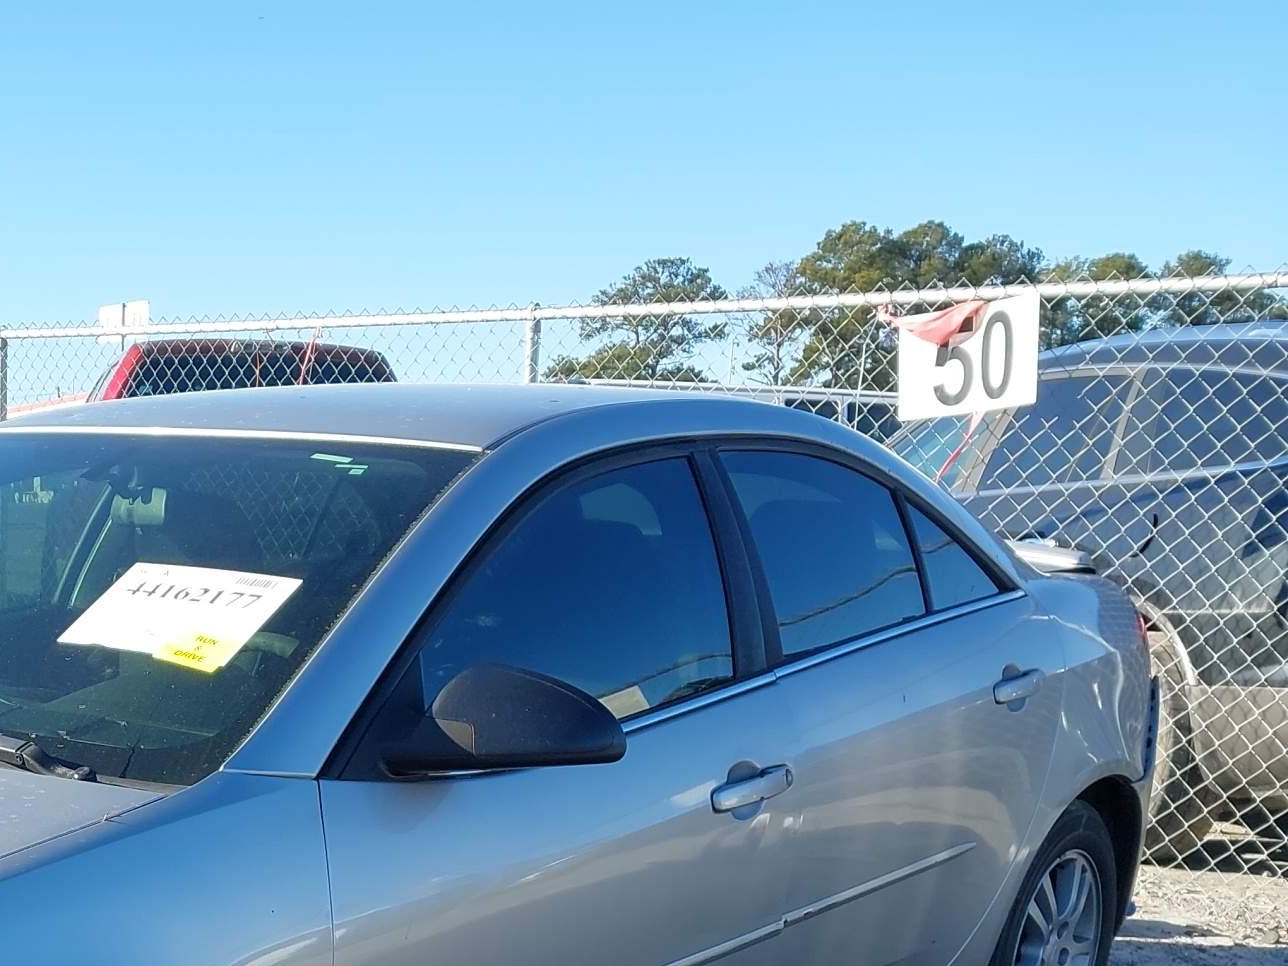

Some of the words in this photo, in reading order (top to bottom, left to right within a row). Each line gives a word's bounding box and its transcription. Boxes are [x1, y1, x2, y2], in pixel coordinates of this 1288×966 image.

[933, 310, 1013, 406] 50
[127, 582, 263, 608] 44162177
[196, 635, 218, 646] RUN
[174, 650, 206, 663] DRIVE
